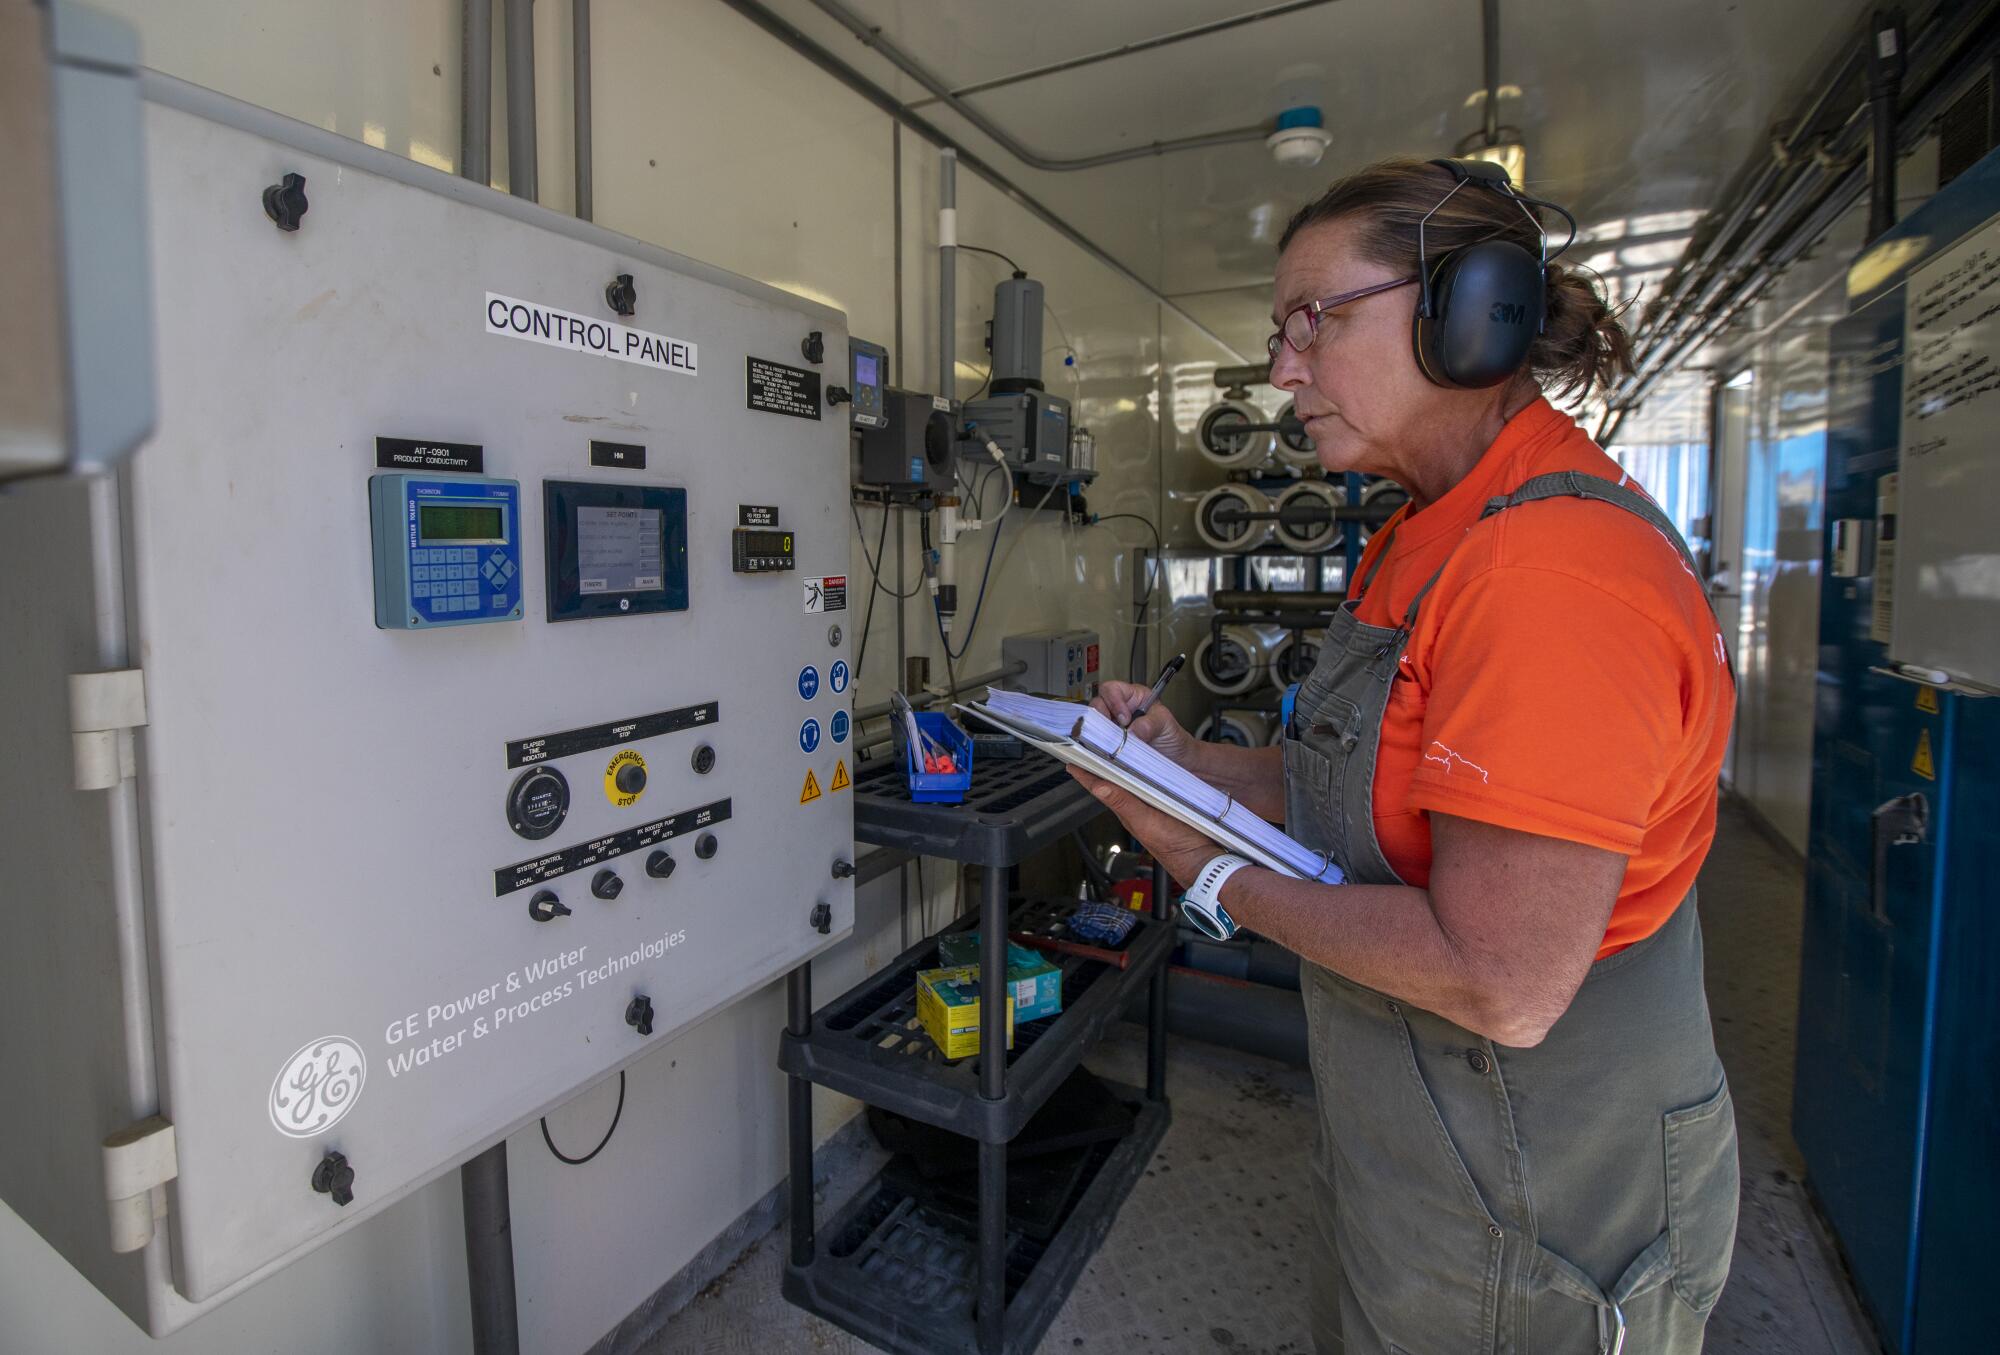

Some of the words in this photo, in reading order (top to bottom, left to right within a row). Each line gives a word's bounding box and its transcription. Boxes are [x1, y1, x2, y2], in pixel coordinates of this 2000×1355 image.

[1489, 302, 1525, 324] 3M
[488, 300, 619, 353] CONTROL
[627, 332, 696, 371] PANEL
[394, 455, 422, 463] PRODUCT
[426, 456, 468, 466] CONDUCTIVITY
[613, 724, 636, 733] EMERGENCY
[523, 740, 545, 749] ELAPSED
[522, 752, 546, 762] INDICATOR
[607, 752, 645, 775] EMERGENCY
[618, 795, 636, 806] STOP
[645, 823, 663, 832] BOOSTER
[589, 842, 600, 850] FEED
[608, 848, 620, 856] AUTO
[517, 862, 538, 873] SYSTEM
[540, 855, 562, 866] CONTROL
[584, 856, 596, 864] HAND
[536, 866, 545, 874] OFF
[544, 866, 564, 877] REMOTE
[516, 877, 533, 887] LOCAL
[386, 1012, 420, 1046] GE
[428, 984, 500, 1028] Power
[506, 972, 521, 993] &
[525, 944, 587, 983] Water
[386, 1030, 466, 1078] Water
[473, 1016, 489, 1039] &
[495, 982, 573, 1030] Process
[577, 928, 686, 990] Technologies
